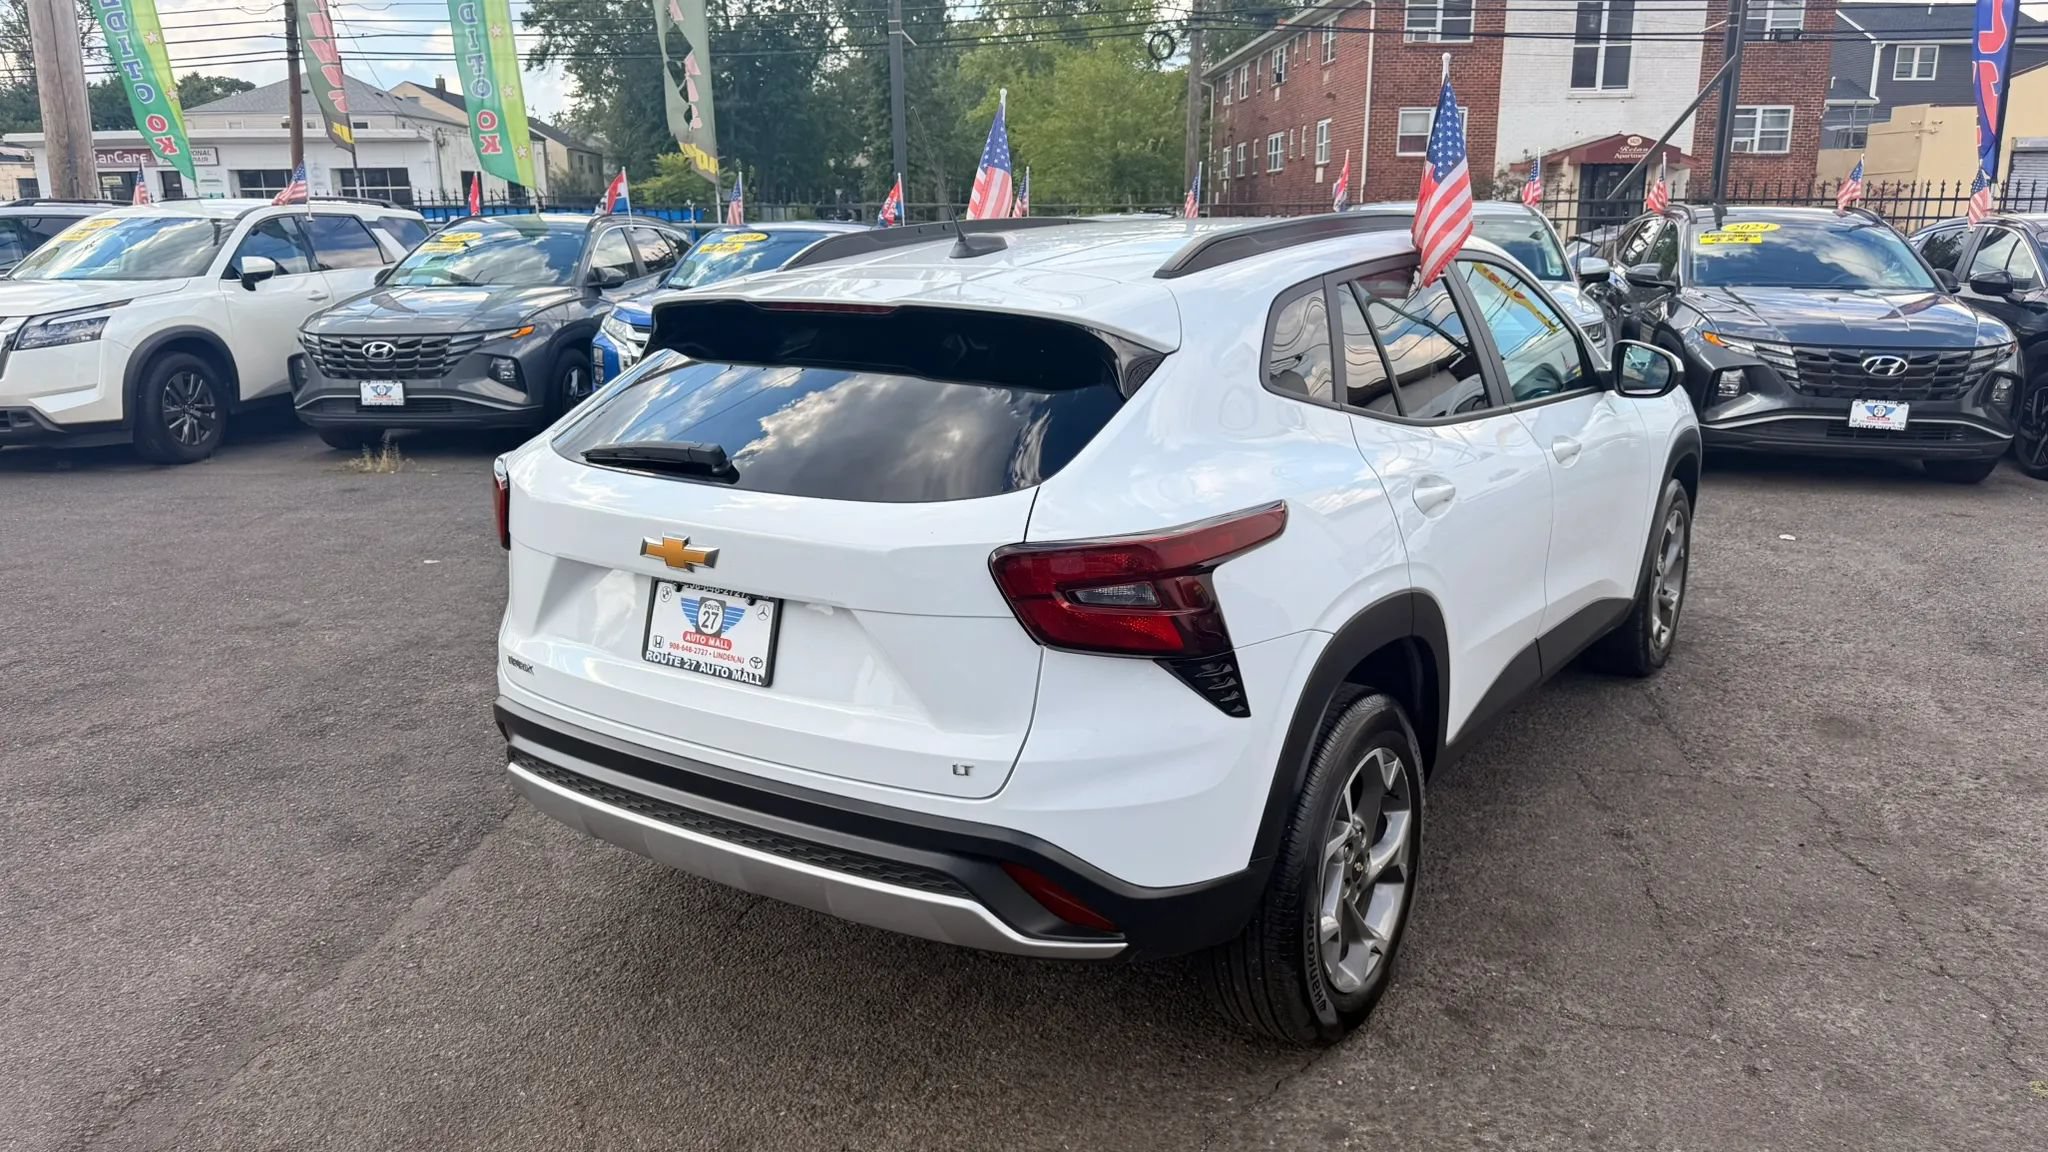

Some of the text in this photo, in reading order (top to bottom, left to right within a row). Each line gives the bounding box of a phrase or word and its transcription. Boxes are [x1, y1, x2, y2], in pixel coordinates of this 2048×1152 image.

[703, 602, 721, 612] ROUTE
[700, 610, 719, 630] 27
[684, 632, 730, 649] AUTO MALL
[645, 651, 762, 686] ROUTE 27 AUTO MALL
[952, 764, 975, 777] LT
